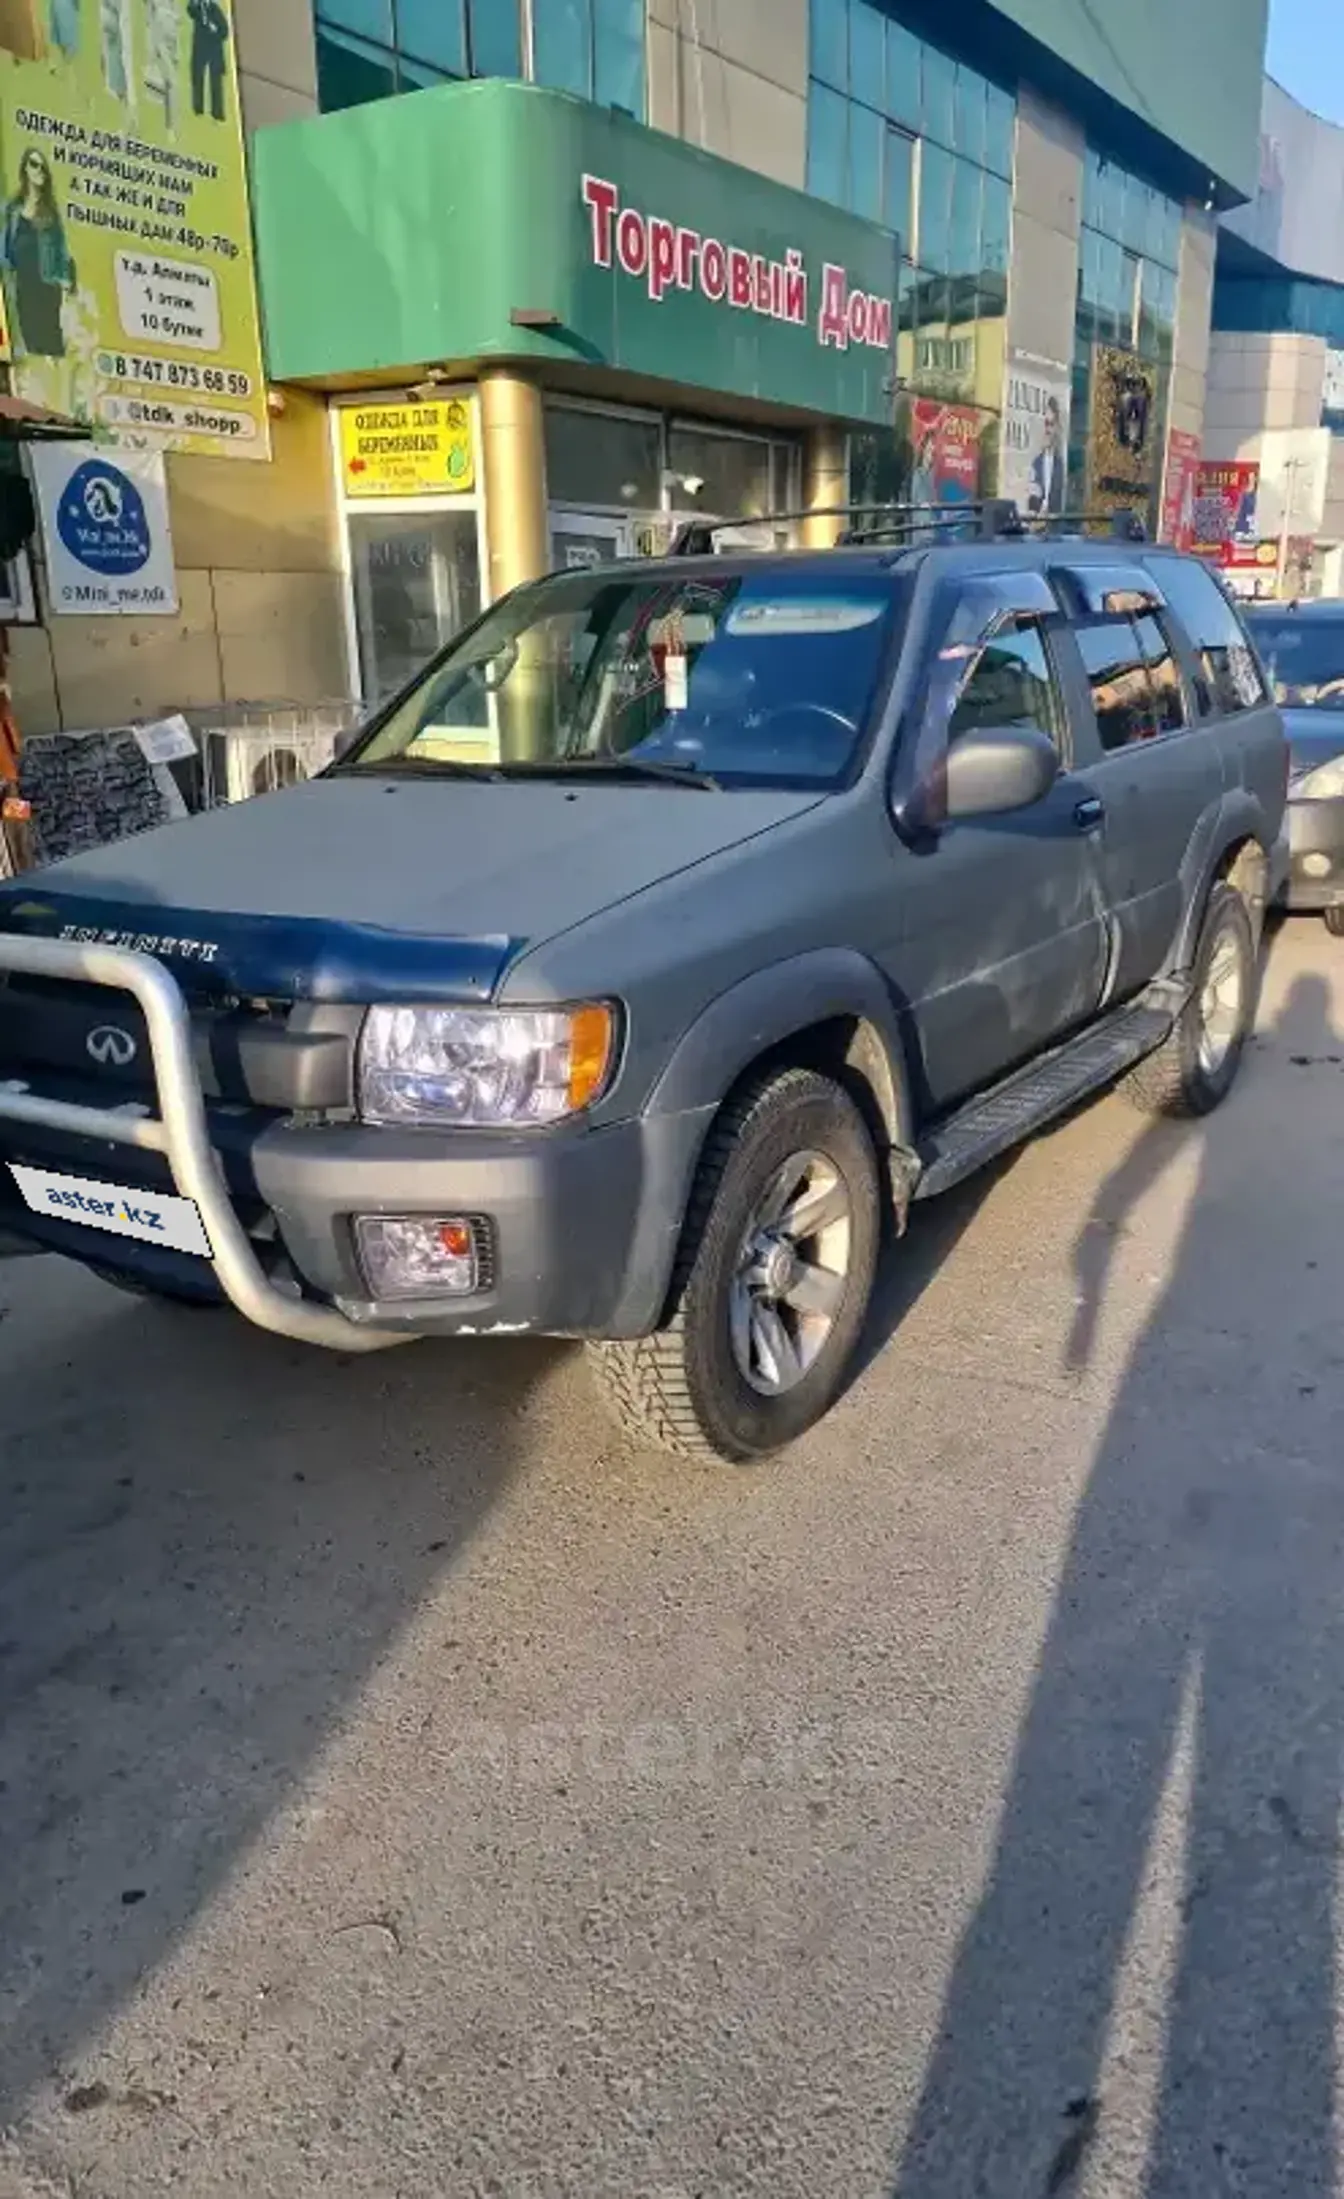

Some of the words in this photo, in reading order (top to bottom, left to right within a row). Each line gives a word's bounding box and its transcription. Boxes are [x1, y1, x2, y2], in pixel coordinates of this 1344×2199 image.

[16, 108, 86, 143] ОДЕЖДА
[90, 130, 121, 152] ДЛЯ
[126, 138, 219, 180] БЕРЕМЕННЫХ
[53, 146, 66, 163] И
[158, 173, 194, 195] МАМ
[83, 178, 111, 200] ТАК
[115, 185, 140, 206] ЖЕ
[143, 192, 153, 210] И
[155, 197, 187, 218] ДЛЯ
[66, 203, 137, 234] ПЫШНЫХ
[140, 219, 172, 242] ДАМ
[581, 172, 807, 326] Торговый
[818, 262, 893, 350] Дом
[140, 312, 159, 330] 10
[115, 354, 127, 377] 8
[131, 357, 164, 382] 747
[167, 362, 200, 388] 873
[202, 368, 225, 393] 68
[227, 373, 249, 396] 59
